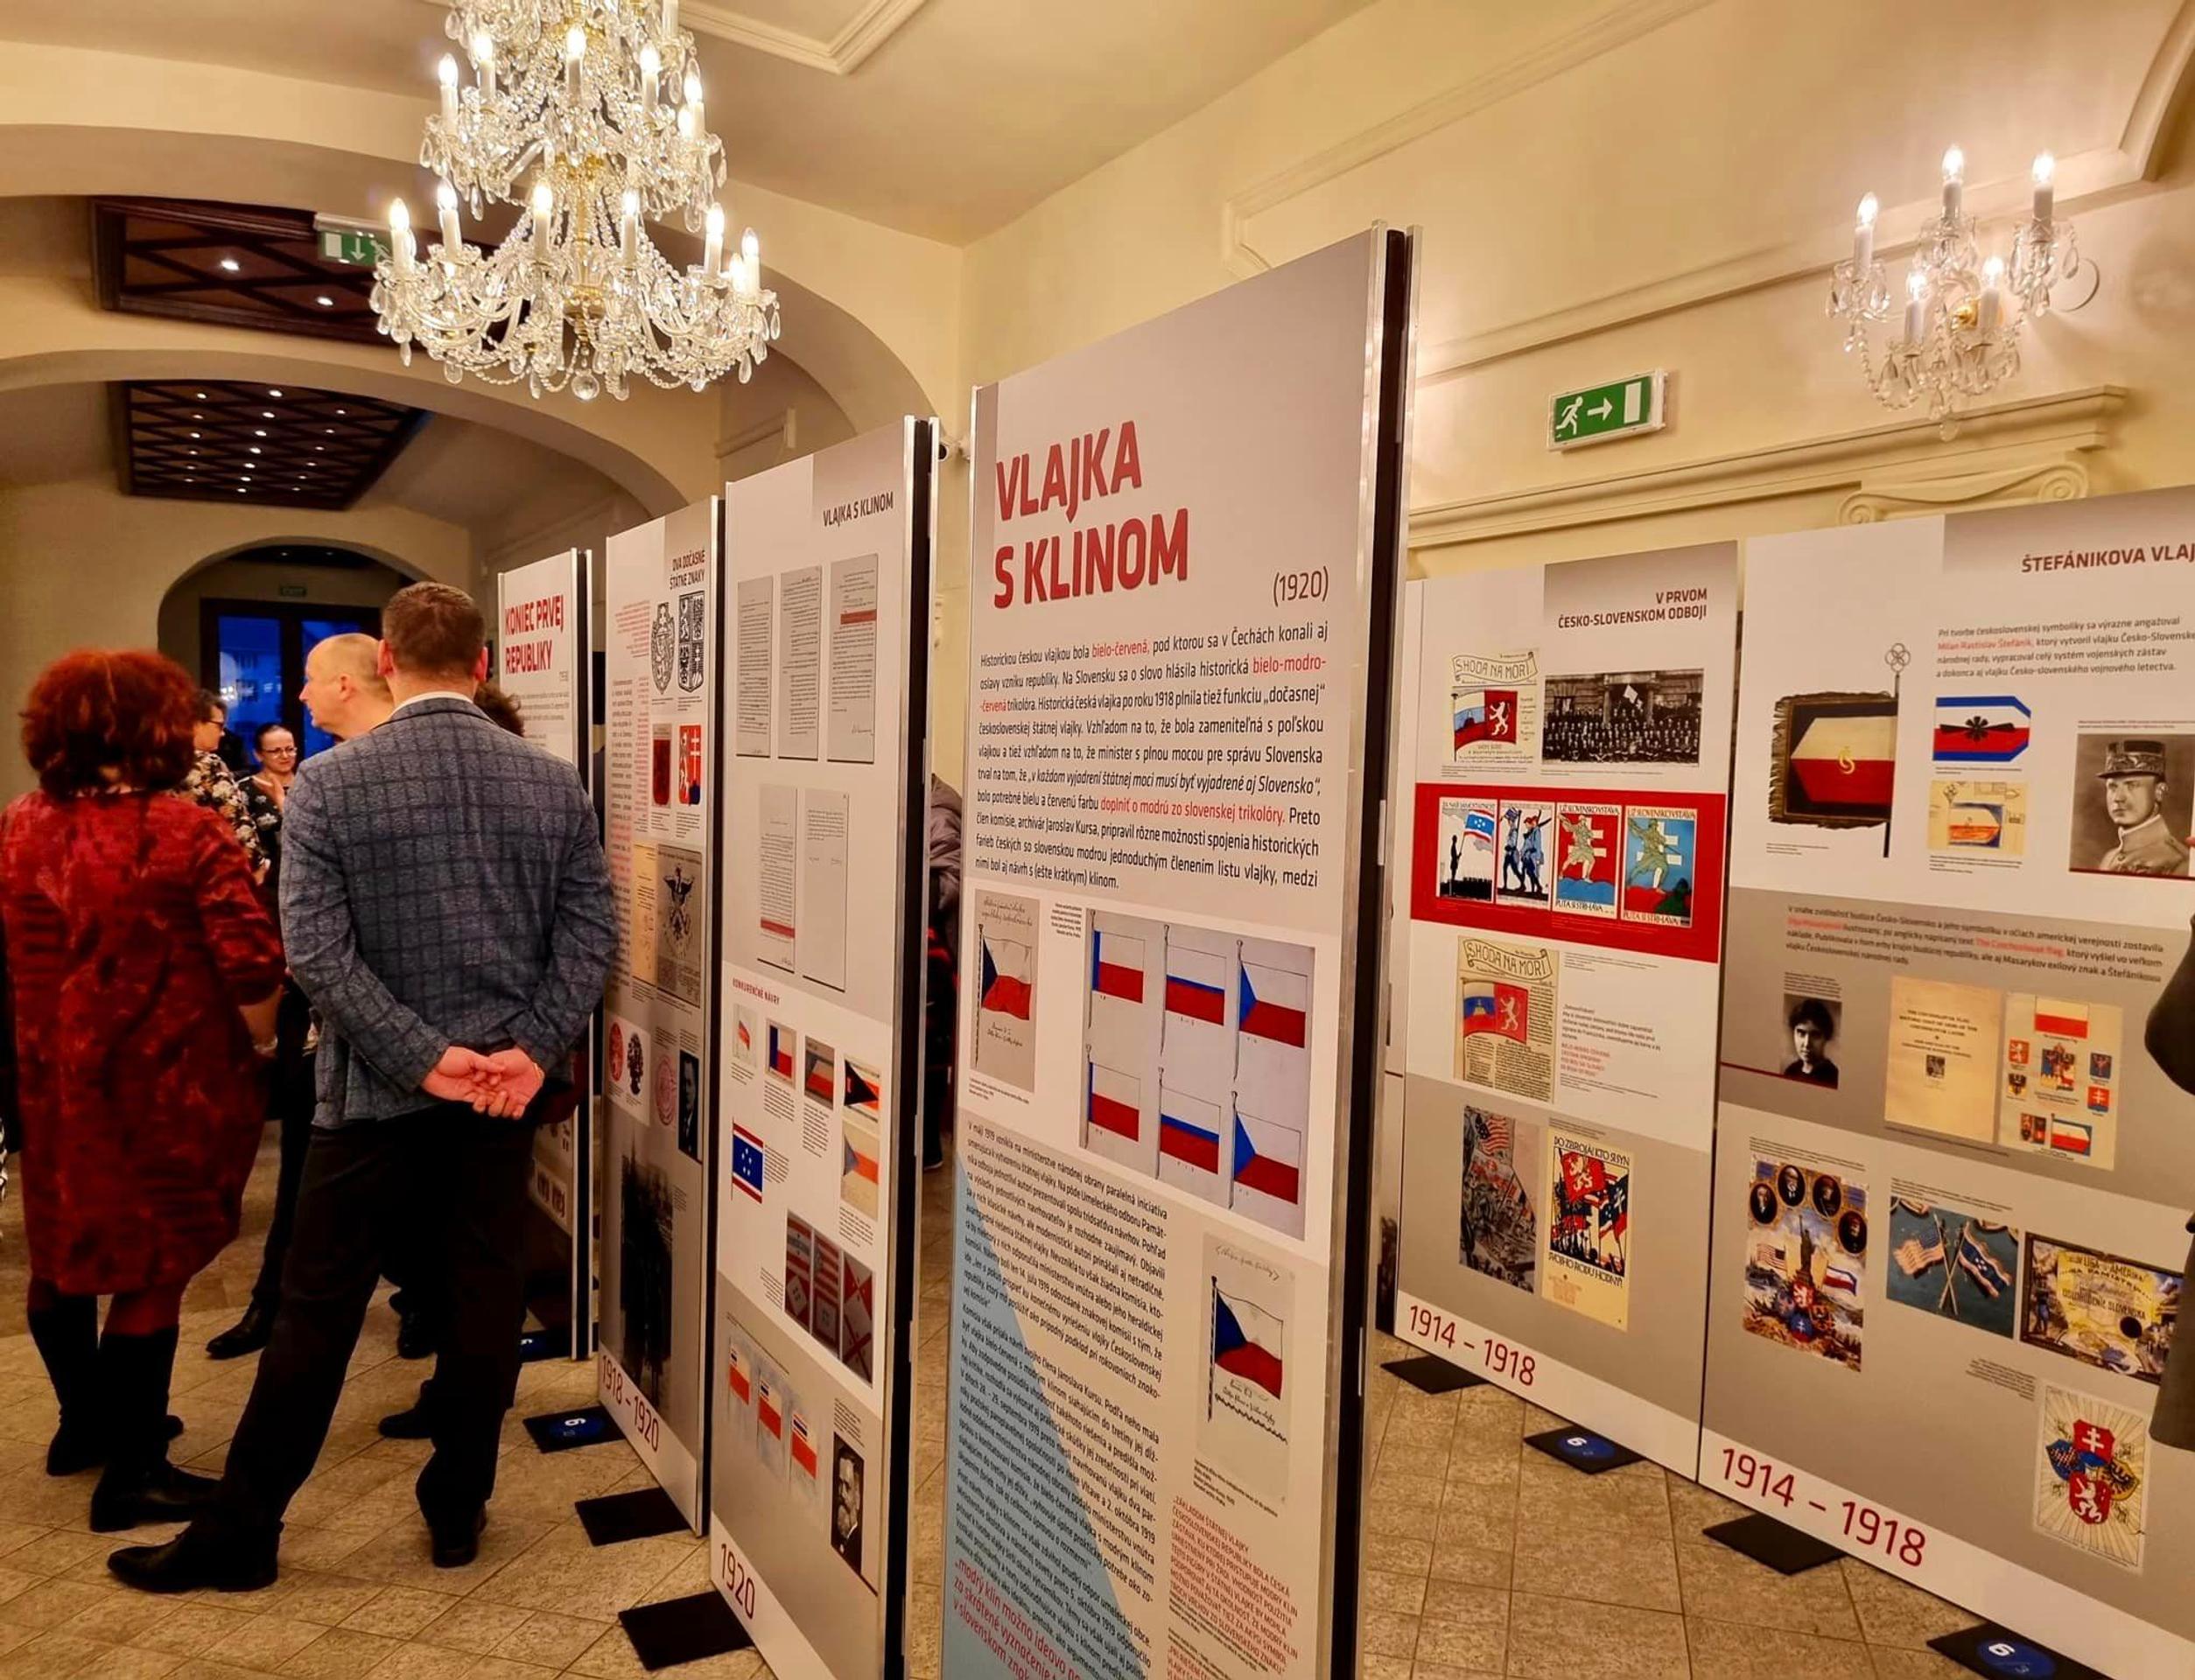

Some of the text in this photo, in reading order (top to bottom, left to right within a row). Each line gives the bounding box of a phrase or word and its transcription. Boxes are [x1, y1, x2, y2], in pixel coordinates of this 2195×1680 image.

[996, 421, 1142, 522] VLAJKA
[823, 491, 894, 528] VLAJKA S KLINOM
[994, 508, 1189, 608] S KLINOM
[2021, 545, 2146, 573] ŠTEFÁNIKOVA
[1273, 565, 1329, 607] (1920)
[1656, 588, 1708, 605] V PRVOM
[505, 594, 565, 636] KONIEC PRVEJ
[1558, 605, 1708, 629] ČESKO-SLOVENSKOM ODBOJI
[506, 640, 553, 674] REPUBLIKY
[1073, 645, 1090, 660] bola
[1090, 639, 1150, 660] bielo-červená,
[1153, 636, 1172, 656] pod
[1173, 635, 1203, 653] ktorou
[1208, 635, 1218, 648] sa
[1222, 634, 1228, 647] v
[1231, 626, 1274, 646] Čechách
[1279, 622, 1313, 641] konali
[1317, 620, 1328, 642] aj
[1075, 668, 1118, 686] Slovensku
[1117, 670, 1128, 686] sa
[1130, 669, 1139, 685] o
[1139, 665, 1163, 683] slovo
[1166, 662, 1198, 679] hlásila
[1200, 658, 1248, 679] historická
[1251, 653, 1326, 676] bielo-modro-
[1490, 664, 1503, 679] NA
[1075, 693, 1097, 712] česká
[1098, 693, 1121, 712] vlajka
[1122, 695, 1134, 712] po
[1133, 691, 1154, 711] roku
[1154, 691, 1174, 706] 1918
[1175, 689, 1201, 710] plnila
[1203, 689, 1222, 705] tiež
[1224, 686, 1262, 707] funkciu
[1086, 718, 1129, 736] Vzhľadom
[1129, 723, 1141, 733] na
[1145, 720, 1157, 735] to,
[1161, 718, 1173, 733] že
[1173, 718, 1196, 735] bola
[1198, 716, 1263, 736] zameniteľná
[1265, 720, 1275, 733] s
[1278, 715, 1323, 737] poľskou
[1073, 746, 1085, 761] to,
[1085, 745, 1097, 763] že
[1098, 746, 1133, 763] minister
[1134, 749, 1140, 762] s
[1143, 746, 1168, 764] plnou
[1172, 747, 1205, 763] mocou
[1205, 749, 1225, 766] pre
[1224, 746, 1261, 766] správu
[1265, 746, 1322, 763] Slovenska
[1067, 770, 1102, 788] vyjadrení
[1102, 771, 1132, 789] štátnej
[1133, 772, 1154, 787] moci
[1155, 773, 1179, 788] musí
[1180, 773, 1196, 792] byť
[1197, 774, 1244, 793] vyjadrené
[1245, 774, 1257, 795] aj
[1047, 794, 1320, 827] červenú farbu doplniť o modrú zo slovenskej trikolóry. Preto
[1076, 819, 1099, 837] Kursa,
[1101, 822, 1135, 841] pripravil
[1136, 825, 1161, 841] rôzne
[1162, 829, 1206, 847] možnosti
[1206, 831, 1249, 851] spojenia
[1252, 834, 1318, 860] historických
[1054, 865, 1087, 886] krátkym)
[1089, 871, 1119, 888] klinom.
[1077, 846, 1107, 864] modrou
[1110, 848, 1168, 871] jednoduchým
[1216, 859, 1240, 878] listu
[1245, 863, 1277, 886] vlajky,
[1283, 869, 1317, 887] medzi
[1504, 955, 1517, 971] NA
[1409, 1305, 1456, 1349] 1914
[1484, 1338, 1536, 1387] 1918
[602, 1354, 660, 1452] 1918 1920
[1722, 1448, 1795, 1508] 1914
[1841, 1501, 1926, 1567] 1918
[721, 1542, 756, 1620] 1920
[985, 1582, 1000, 1609] klin
[1002, 1602, 1033, 1642] možno
